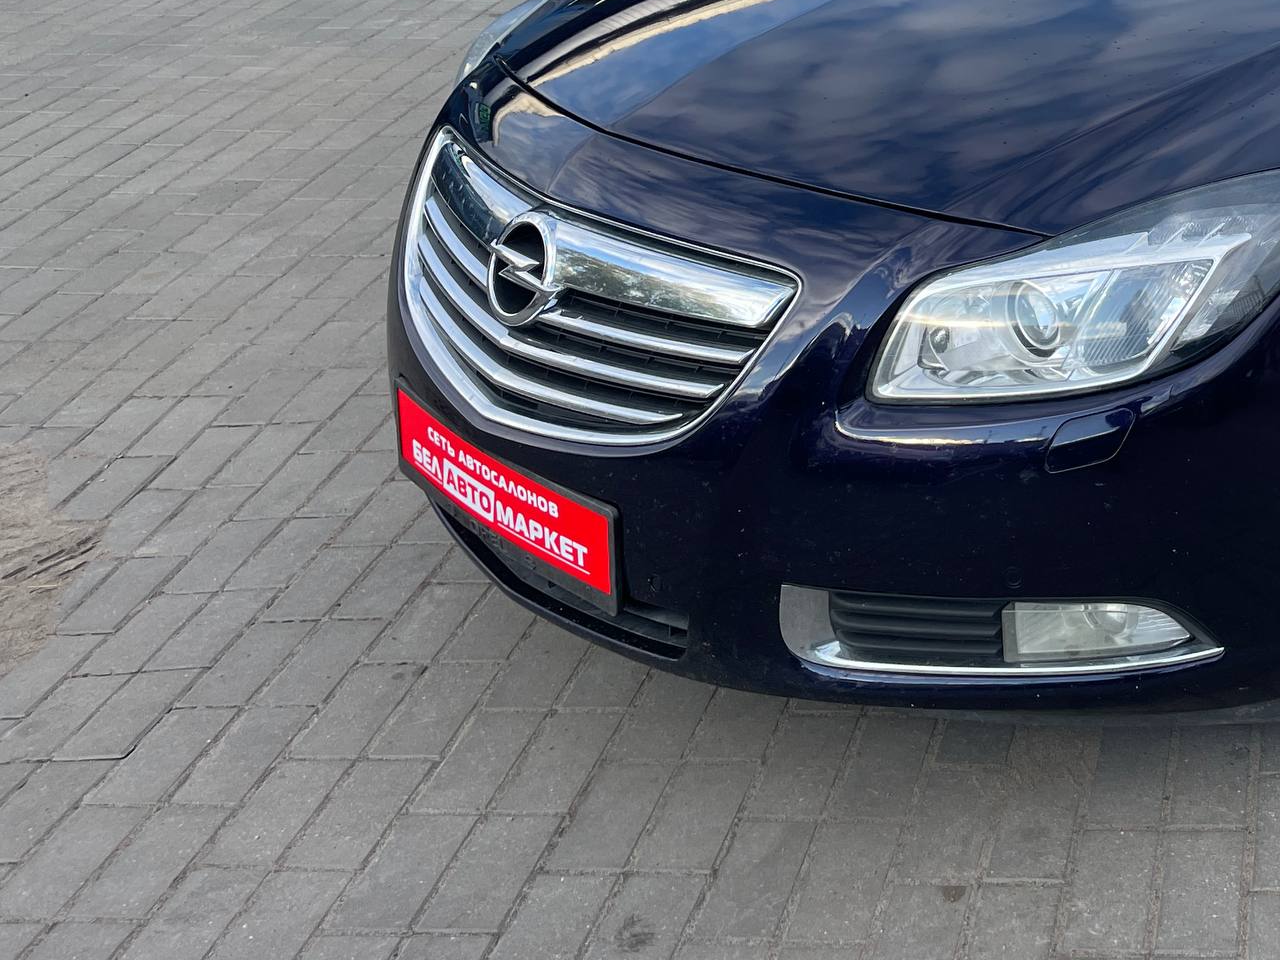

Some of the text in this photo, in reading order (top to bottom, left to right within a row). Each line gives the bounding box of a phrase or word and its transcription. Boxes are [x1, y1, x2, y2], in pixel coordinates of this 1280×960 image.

[411, 438, 443, 482] БЕЛ
[445, 466, 494, 514] АВТО
[495, 500, 589, 568] МАРКЕТ
[426, 426, 560, 519] СЕТЬ АВТОСАЛОНОВ
